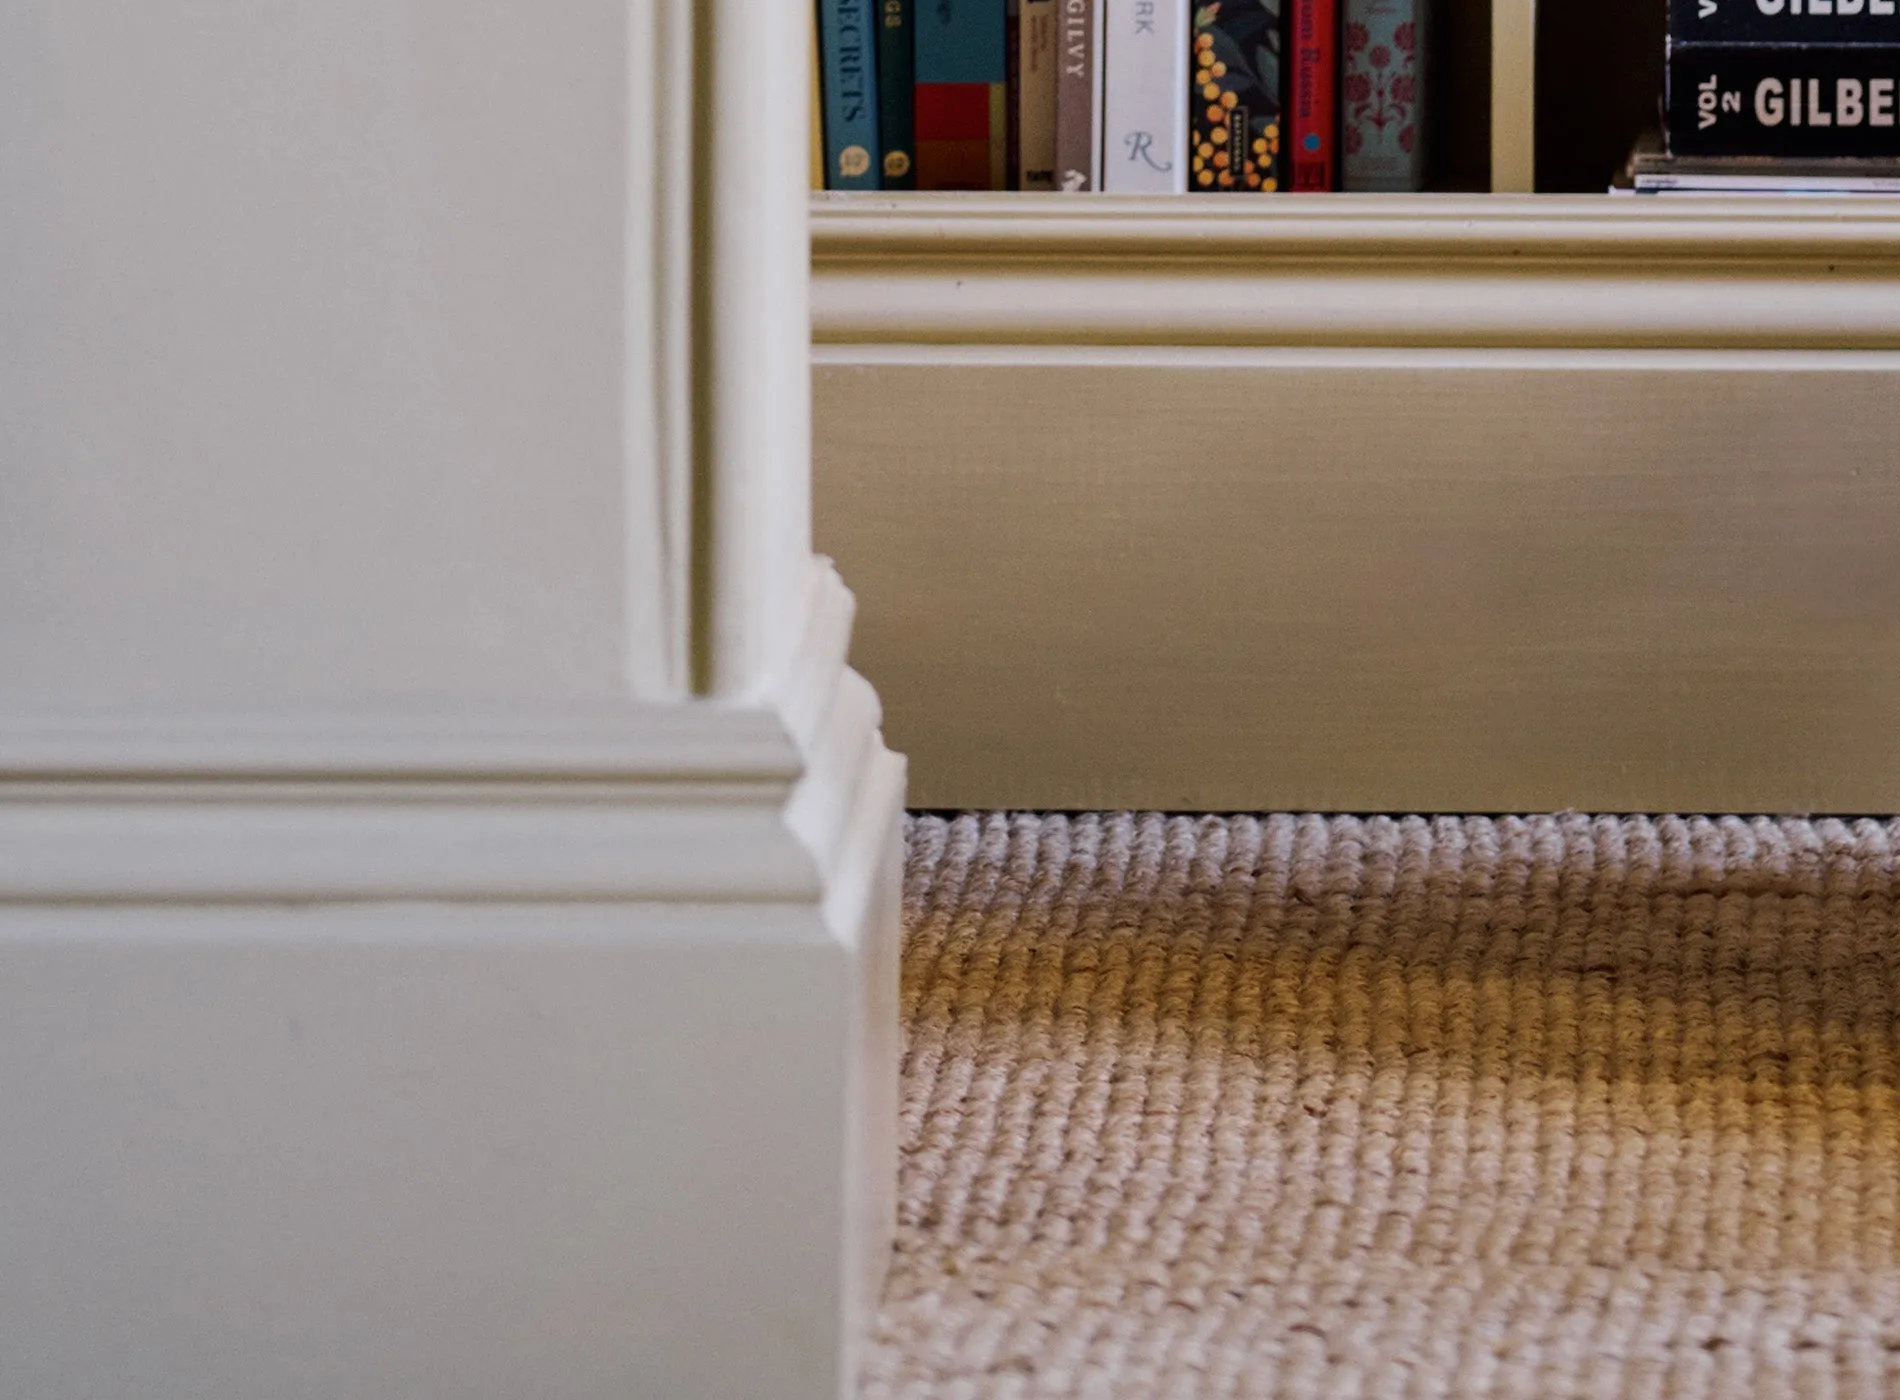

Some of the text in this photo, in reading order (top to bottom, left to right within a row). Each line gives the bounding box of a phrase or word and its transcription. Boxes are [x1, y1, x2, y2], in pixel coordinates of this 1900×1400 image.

[1299, 31, 1321, 118] Russia
[1697, 73, 1718, 130] VOL
[1721, 90, 1742, 113] 2
